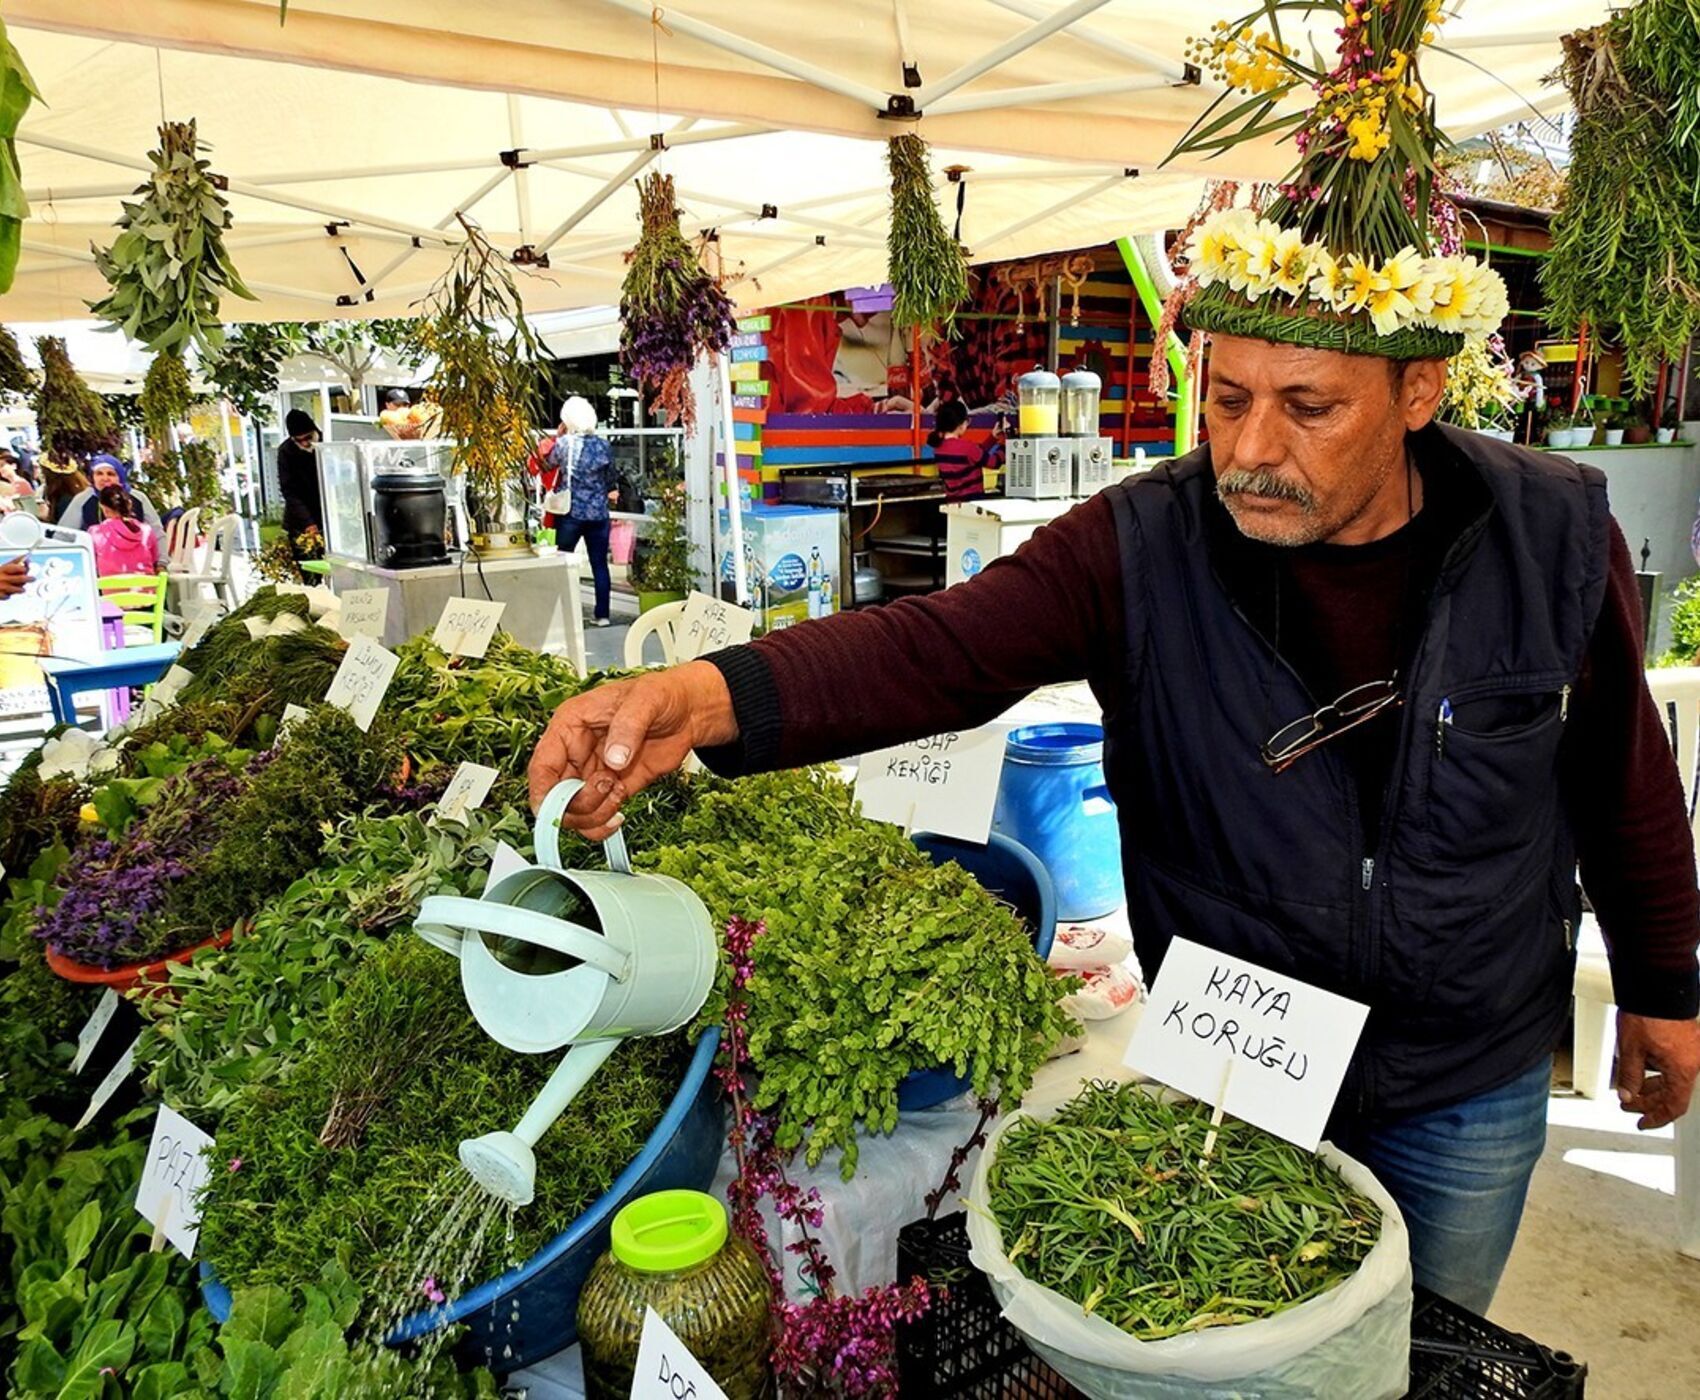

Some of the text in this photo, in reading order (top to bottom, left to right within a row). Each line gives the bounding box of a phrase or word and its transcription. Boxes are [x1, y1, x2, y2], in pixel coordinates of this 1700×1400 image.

[445, 609, 491, 635] RADİKA
[704, 602, 728, 625] KAZ
[903, 732, 959, 751] SAP
[886, 755, 952, 784] KEKİĞİ
[1204, 965, 1292, 1020] KAYA
[1163, 1000, 1309, 1081] KORUĞU
